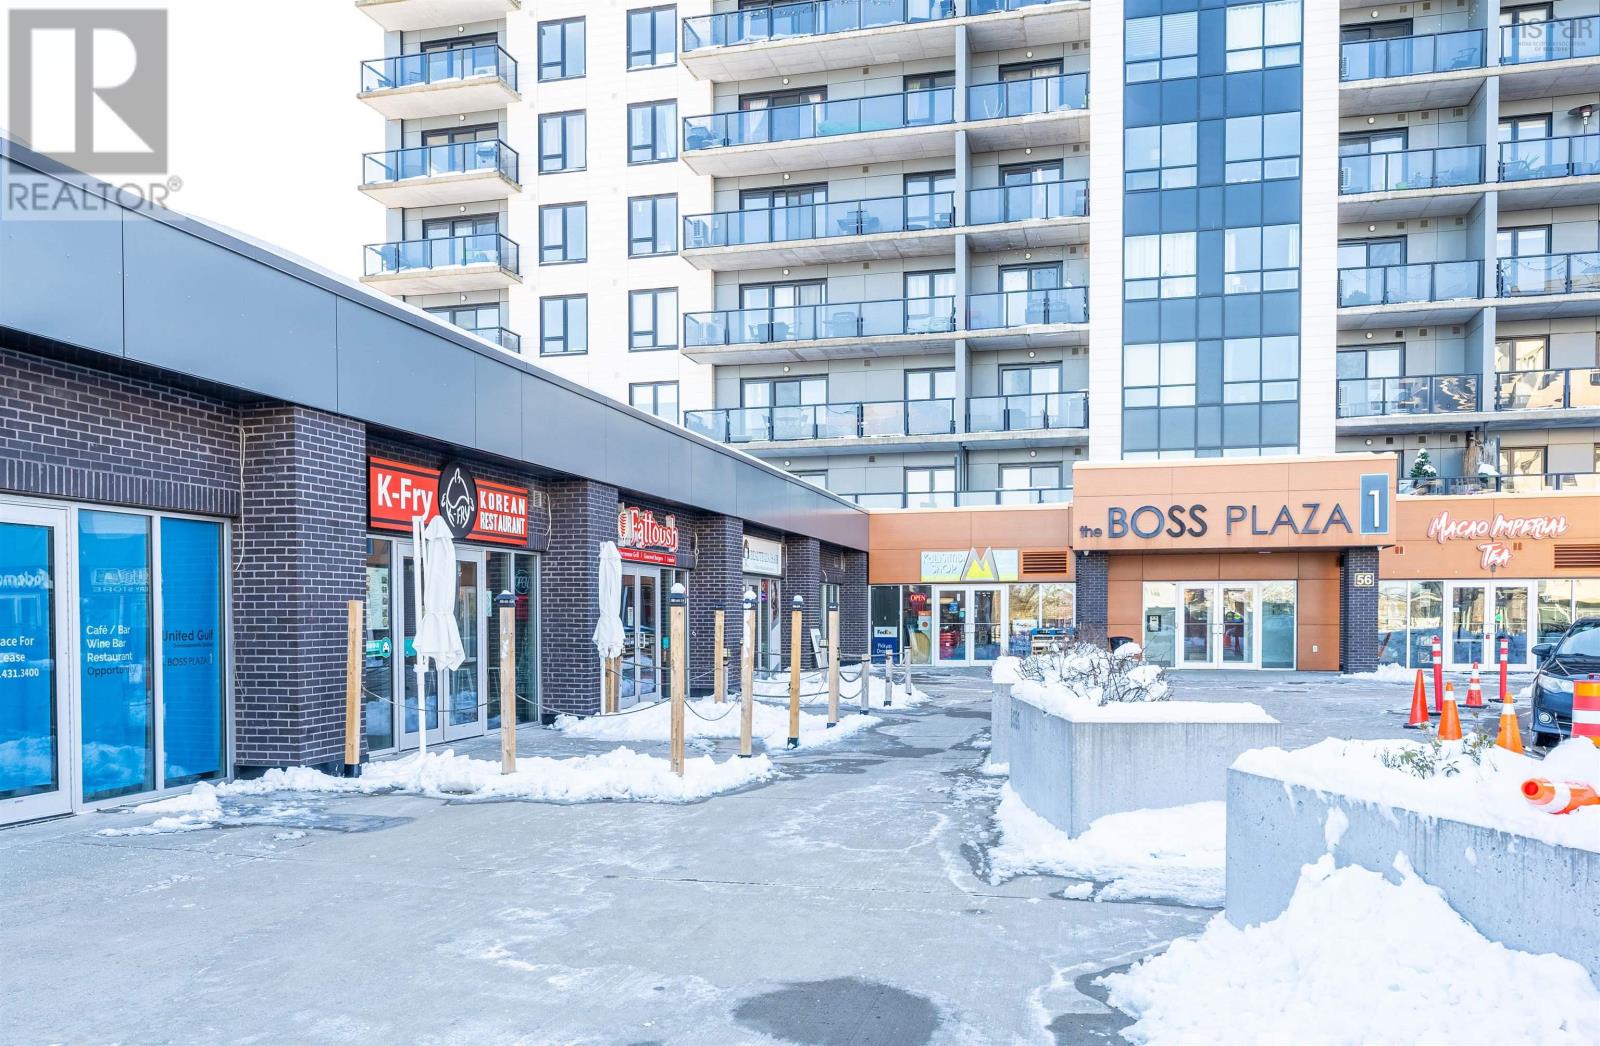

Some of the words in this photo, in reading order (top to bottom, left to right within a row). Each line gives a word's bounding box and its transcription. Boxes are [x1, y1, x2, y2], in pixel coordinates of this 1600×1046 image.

[377, 473, 433, 521] K-Fry
[480, 490, 526, 515] KOREAN
[1368, 489, 1380, 528] 1
[480, 511, 525, 535] RESTAURANT
[1079, 525, 1103, 538] the
[1108, 504, 1207, 539] BOSS
[1226, 502, 1353, 536] PLAZA
[629, 507, 678, 552] Fattoush
[1357, 574, 1372, 586] 56
[910, 594, 926, 602] OPEN
[86, 624, 108, 635] Café
[118, 625, 131, 635] Bar
[198, 628, 214, 641] Gulf
[19, 636, 35, 646] For
[86, 638, 111, 648] Wine
[112, 638, 127, 648] Bar
[87, 651, 133, 663] Restaurant
